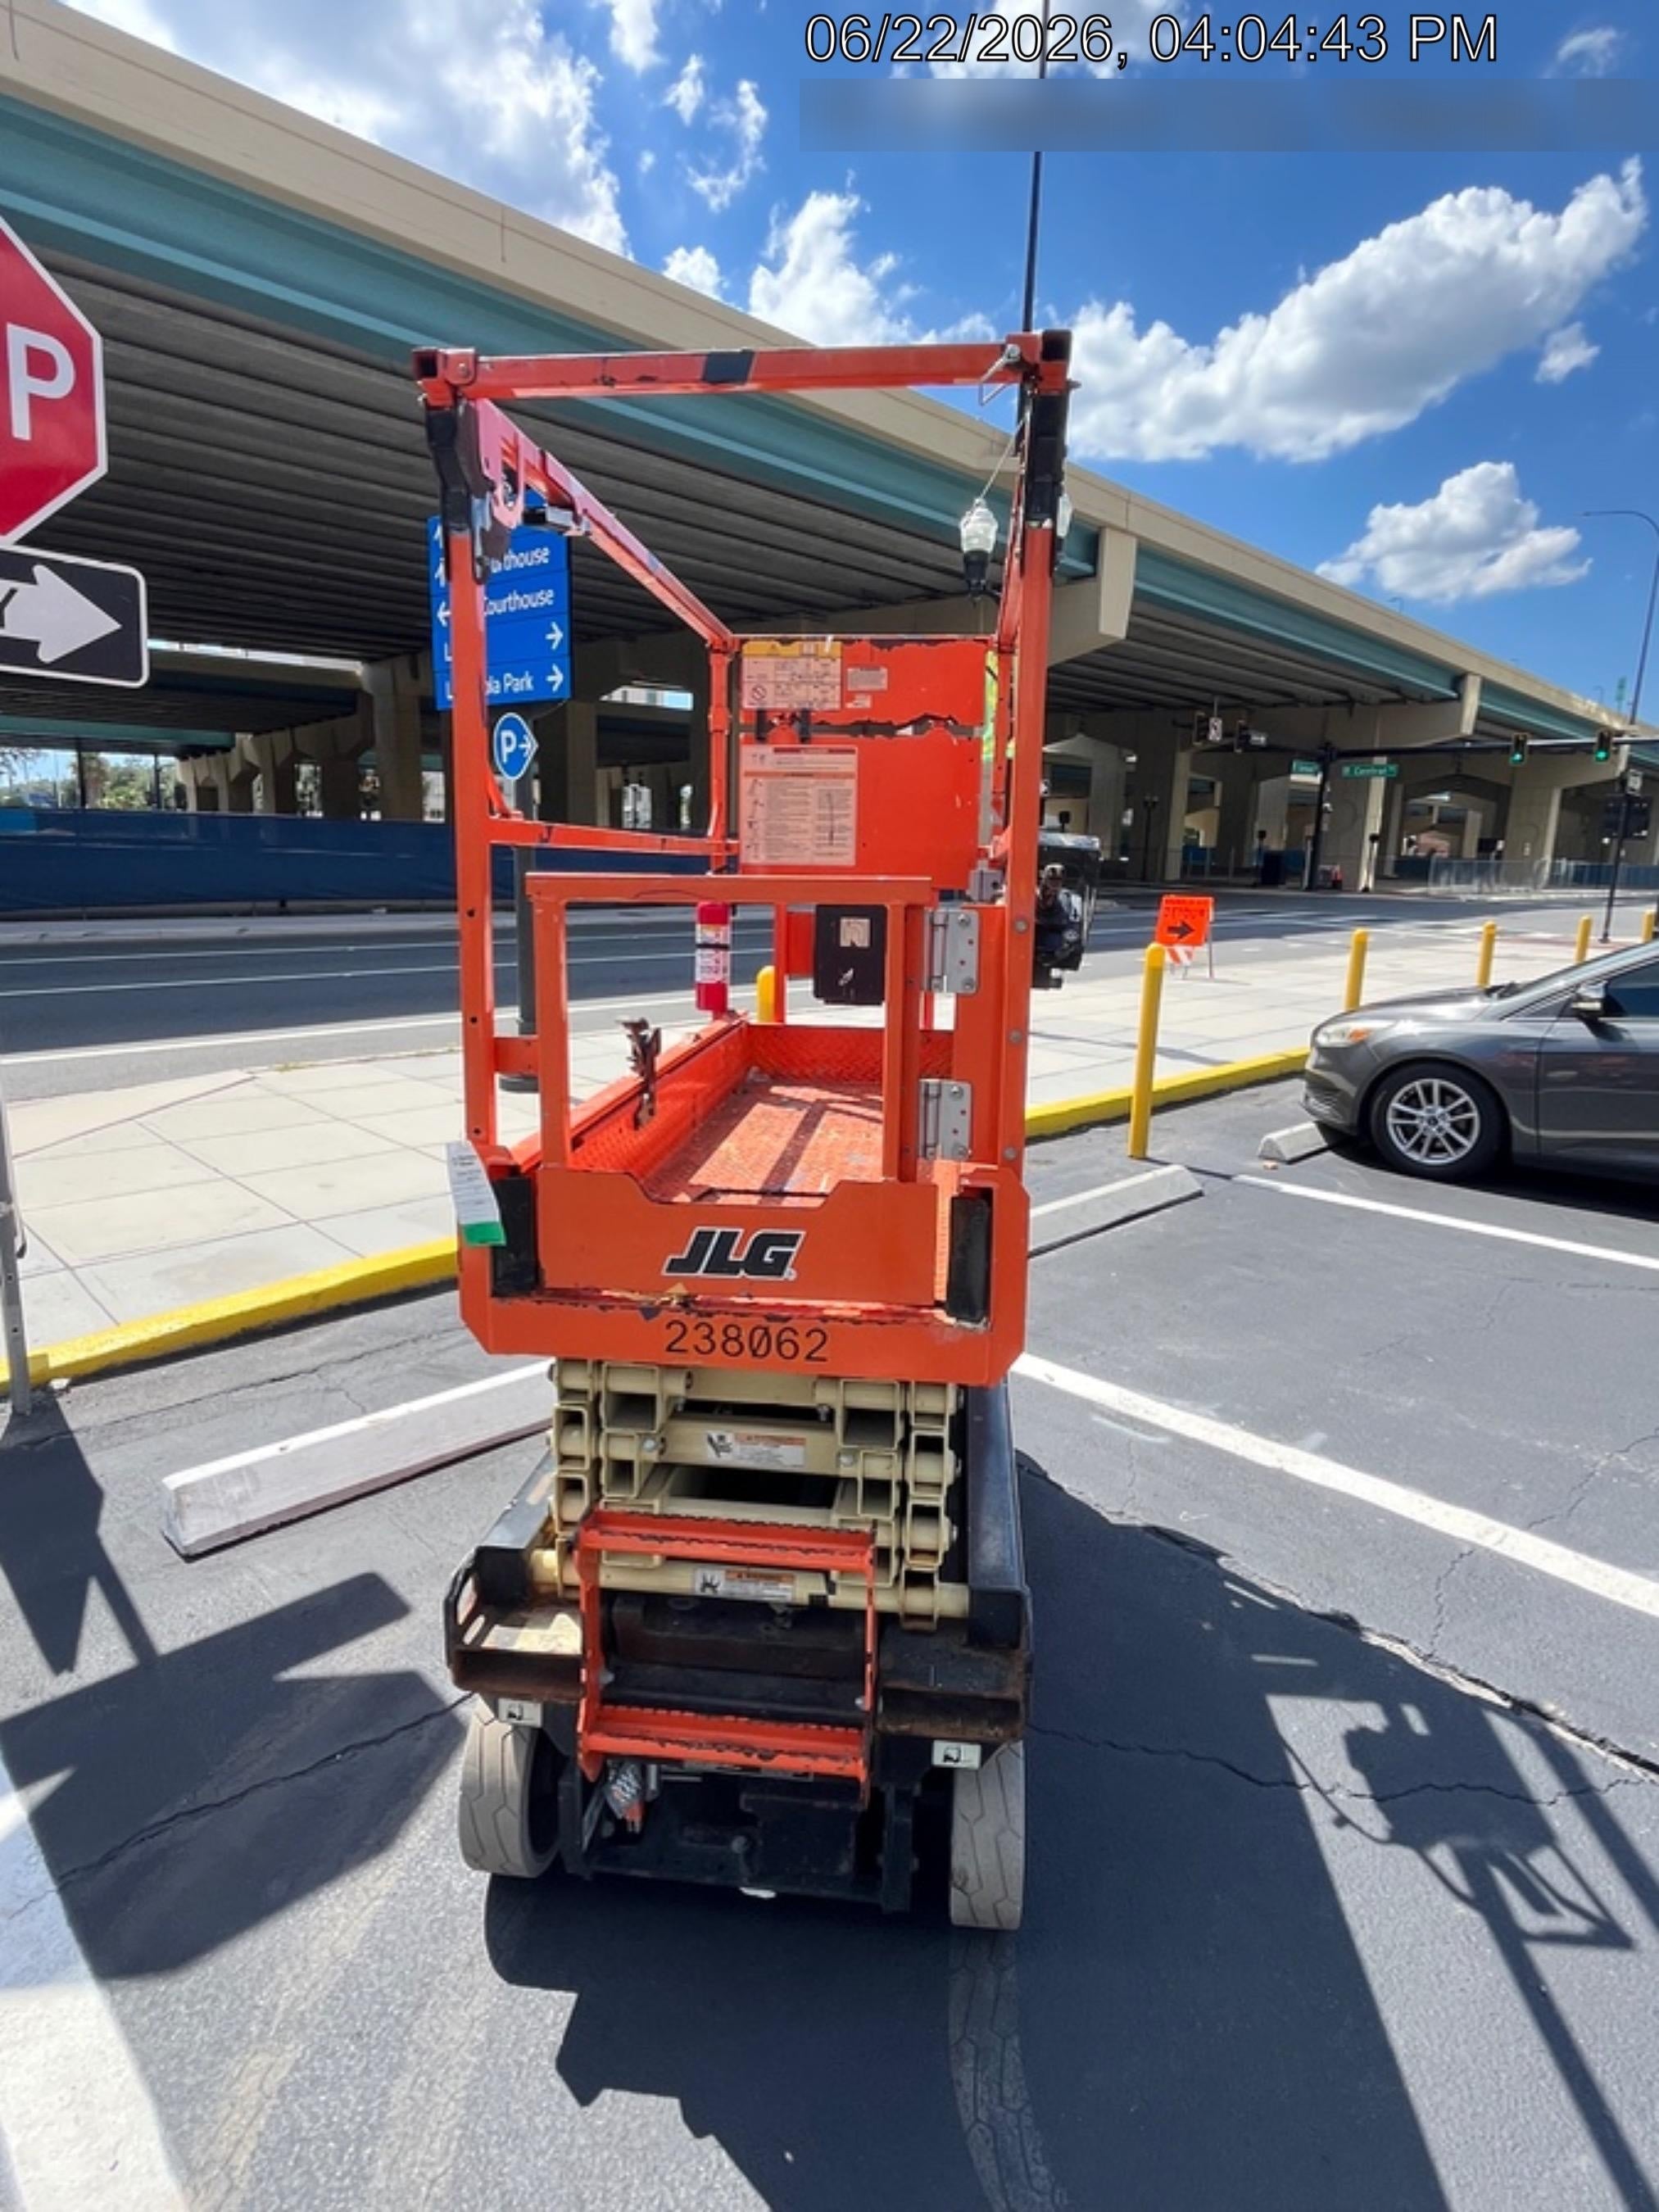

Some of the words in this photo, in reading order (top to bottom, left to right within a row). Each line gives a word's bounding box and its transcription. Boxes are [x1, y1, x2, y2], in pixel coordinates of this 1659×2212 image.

[503, 670, 534, 694] Park
[500, 729, 517, 764] P
[661, 1226, 806, 1281] JLG
[665, 1320, 829, 1362] 238062
